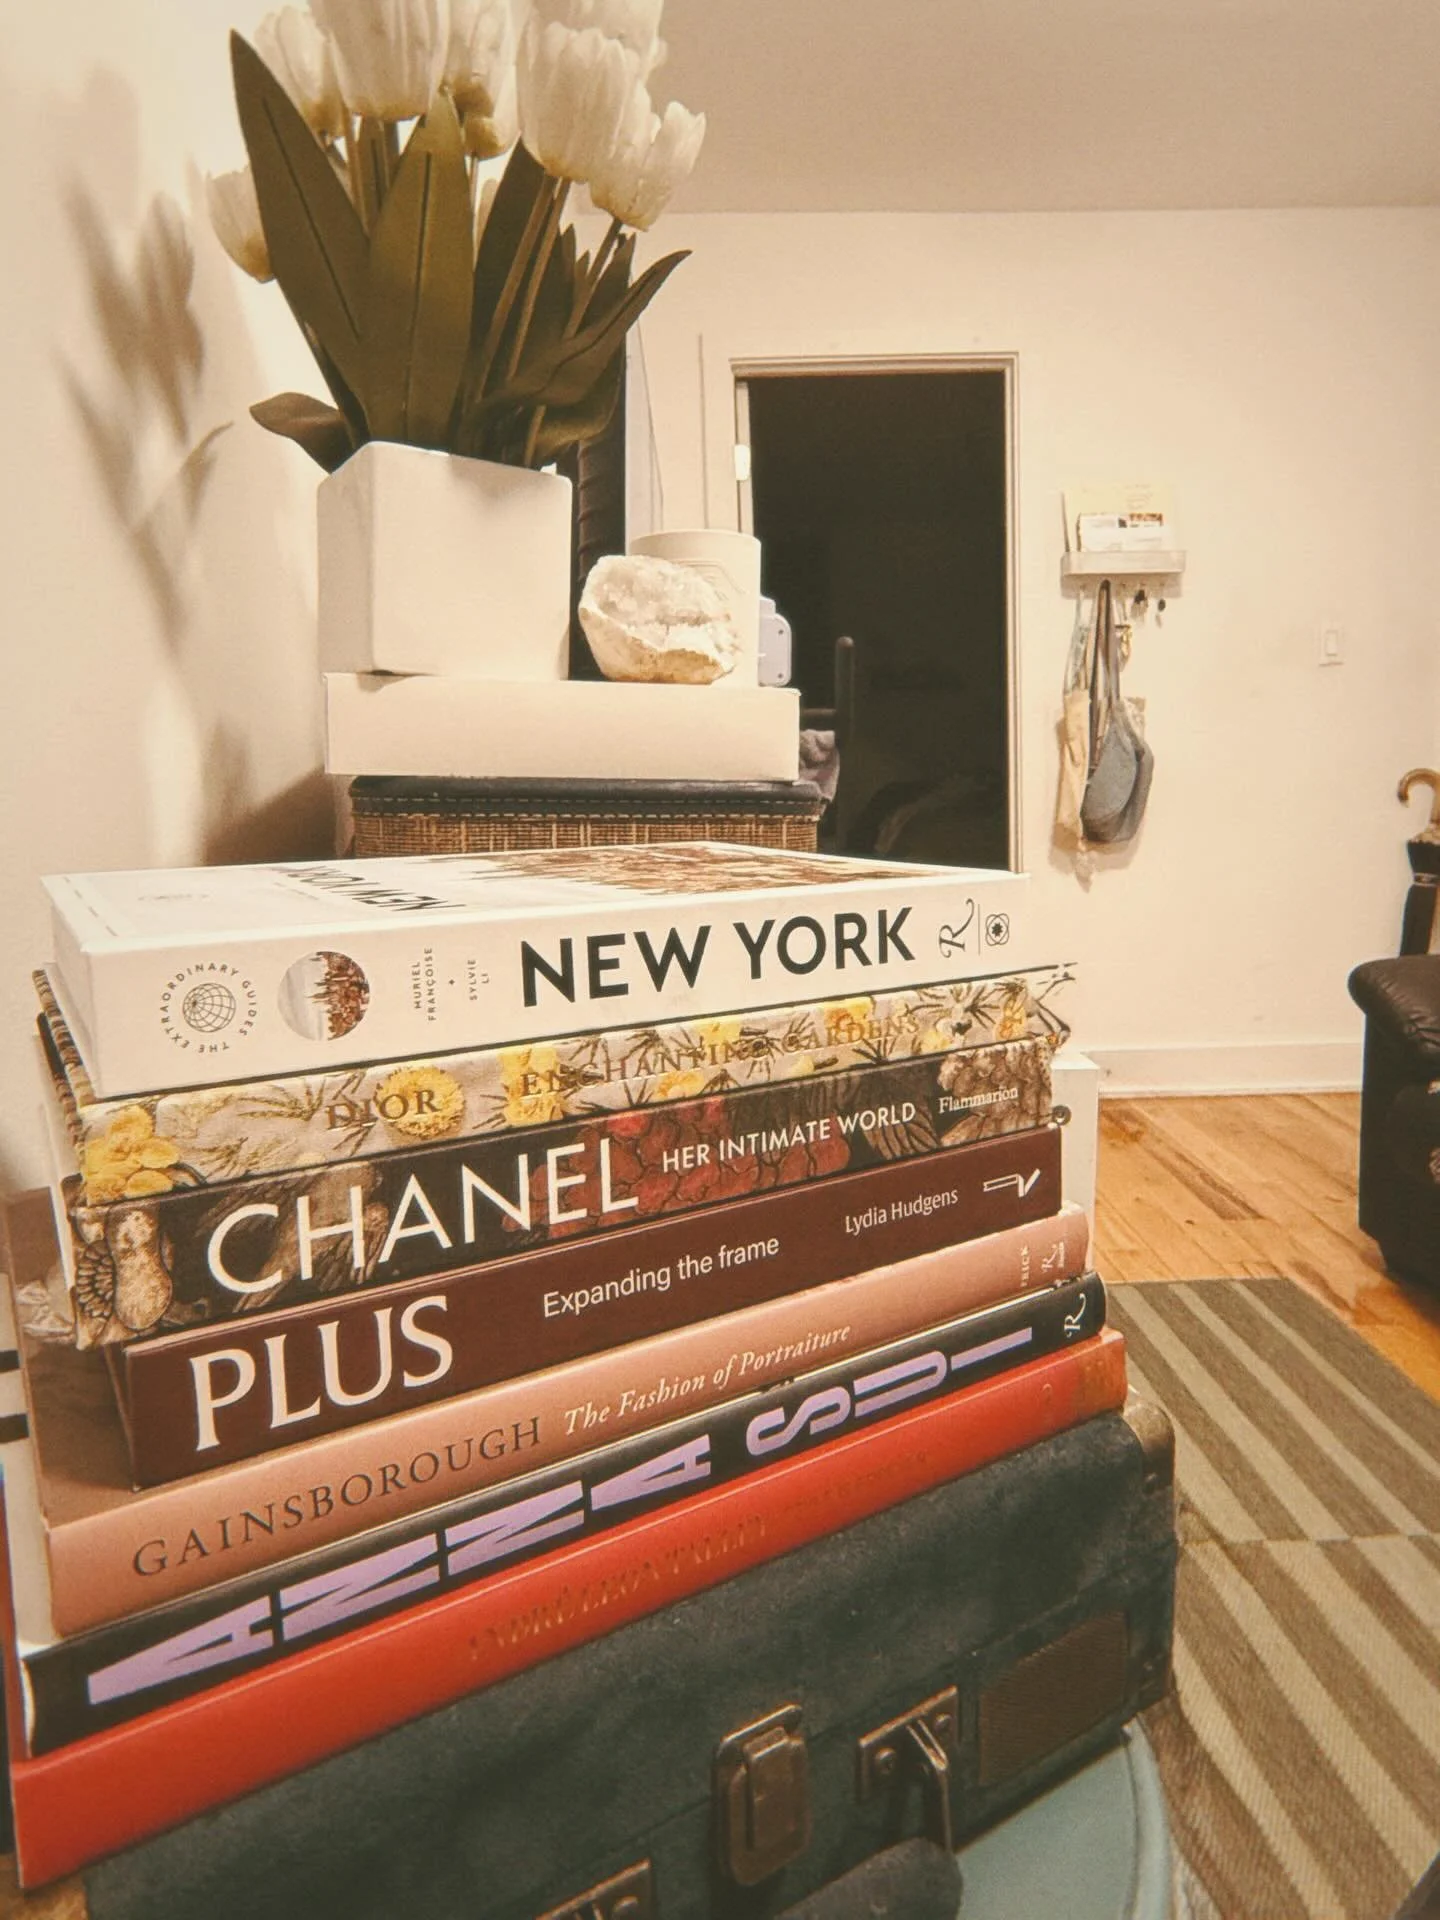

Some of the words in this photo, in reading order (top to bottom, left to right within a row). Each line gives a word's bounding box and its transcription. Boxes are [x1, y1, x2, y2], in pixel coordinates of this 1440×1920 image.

[411, 961, 422, 1009] MURIEL
[424, 947, 437, 1021] FRANÇOISE
[467, 959, 478, 1001] SYLVIE
[481, 972, 490, 984] LI
[521, 925, 711, 1007] NEW
[733, 906, 916, 980] YORK
[159, 962, 240, 1049] EXTRAORDINARY
[239, 980, 257, 1036] GUIDES
[197, 1041, 230, 1054] THE
[325, 1089, 441, 1131] DIOR
[781, 1013, 921, 1054] GARDENS
[662, 1144, 710, 1173] HER
[719, 1118, 832, 1160] INTIMATE
[840, 1101, 916, 1135] WORLD
[938, 1085, 1020, 1114] Flammarion
[208, 1138, 639, 1294] CHANEL
[845, 1207, 888, 1237] Lydia
[891, 1189, 959, 1220] Hudgens
[543, 1265, 672, 1318] Expanding
[677, 1253, 714, 1281] the
[718, 1237, 780, 1269] frame
[189, 1295, 454, 1452] PLUS
[564, 1402, 611, 1437] The
[617, 1372, 706, 1418] Fashion
[713, 1354, 738, 1390] of
[738, 1326, 850, 1377] Portraiture
[88, 1435, 711, 1704] ANNA
[746, 1327, 1032, 1456] SUI
[133, 1417, 540, 1577] GAINSBOROUGH
